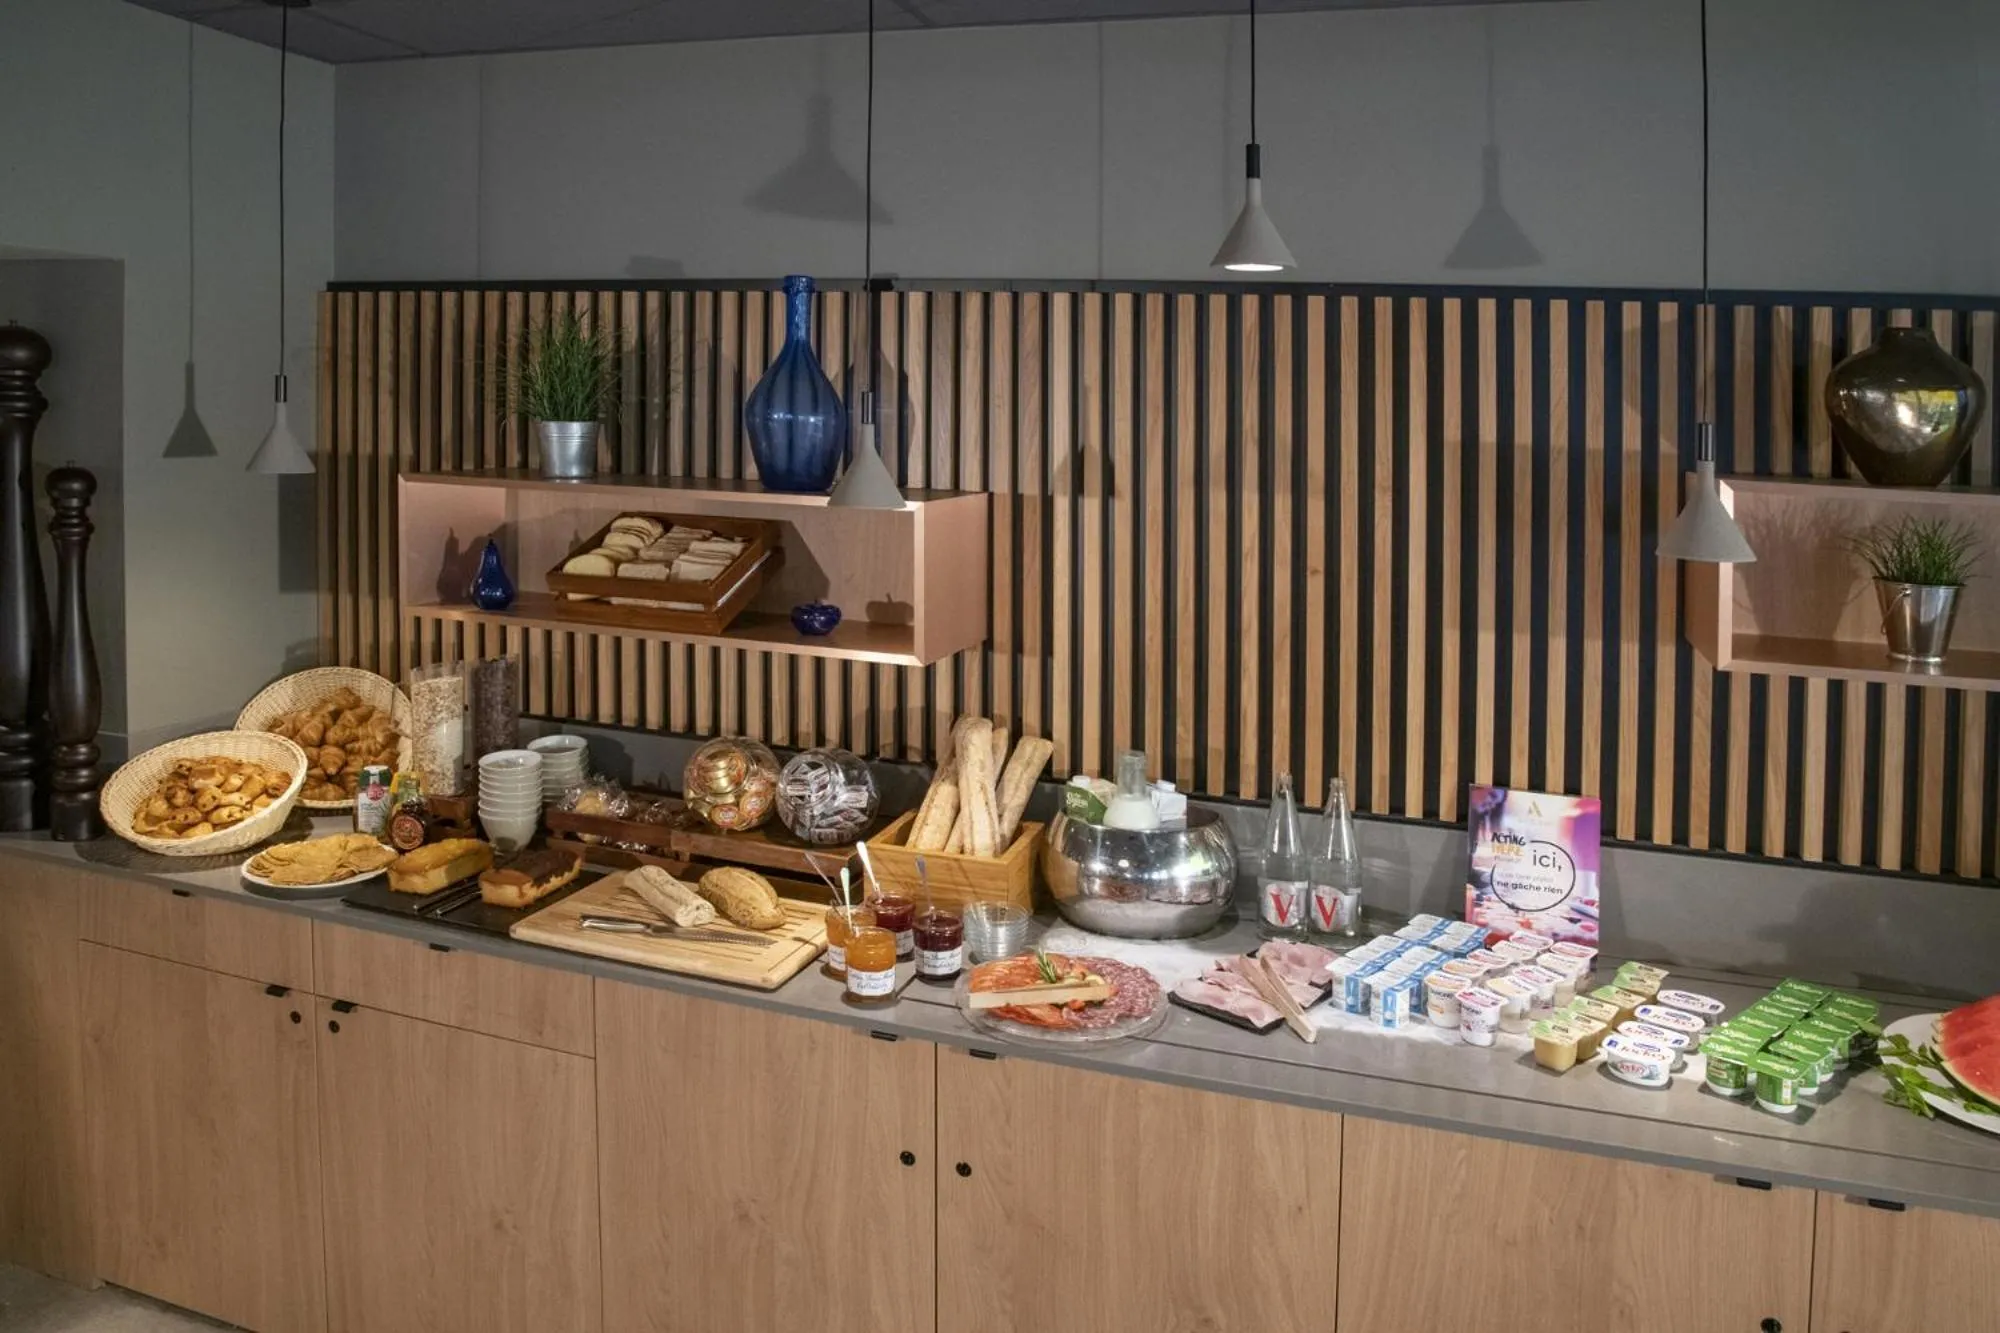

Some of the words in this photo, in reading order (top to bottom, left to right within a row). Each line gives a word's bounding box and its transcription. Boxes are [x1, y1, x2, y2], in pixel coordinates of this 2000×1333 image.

[1532, 849, 1562, 872] ici,
[1543, 885, 1563, 894] rien
[1270, 893, 1294, 925] V
[1315, 895, 1339, 928] V
